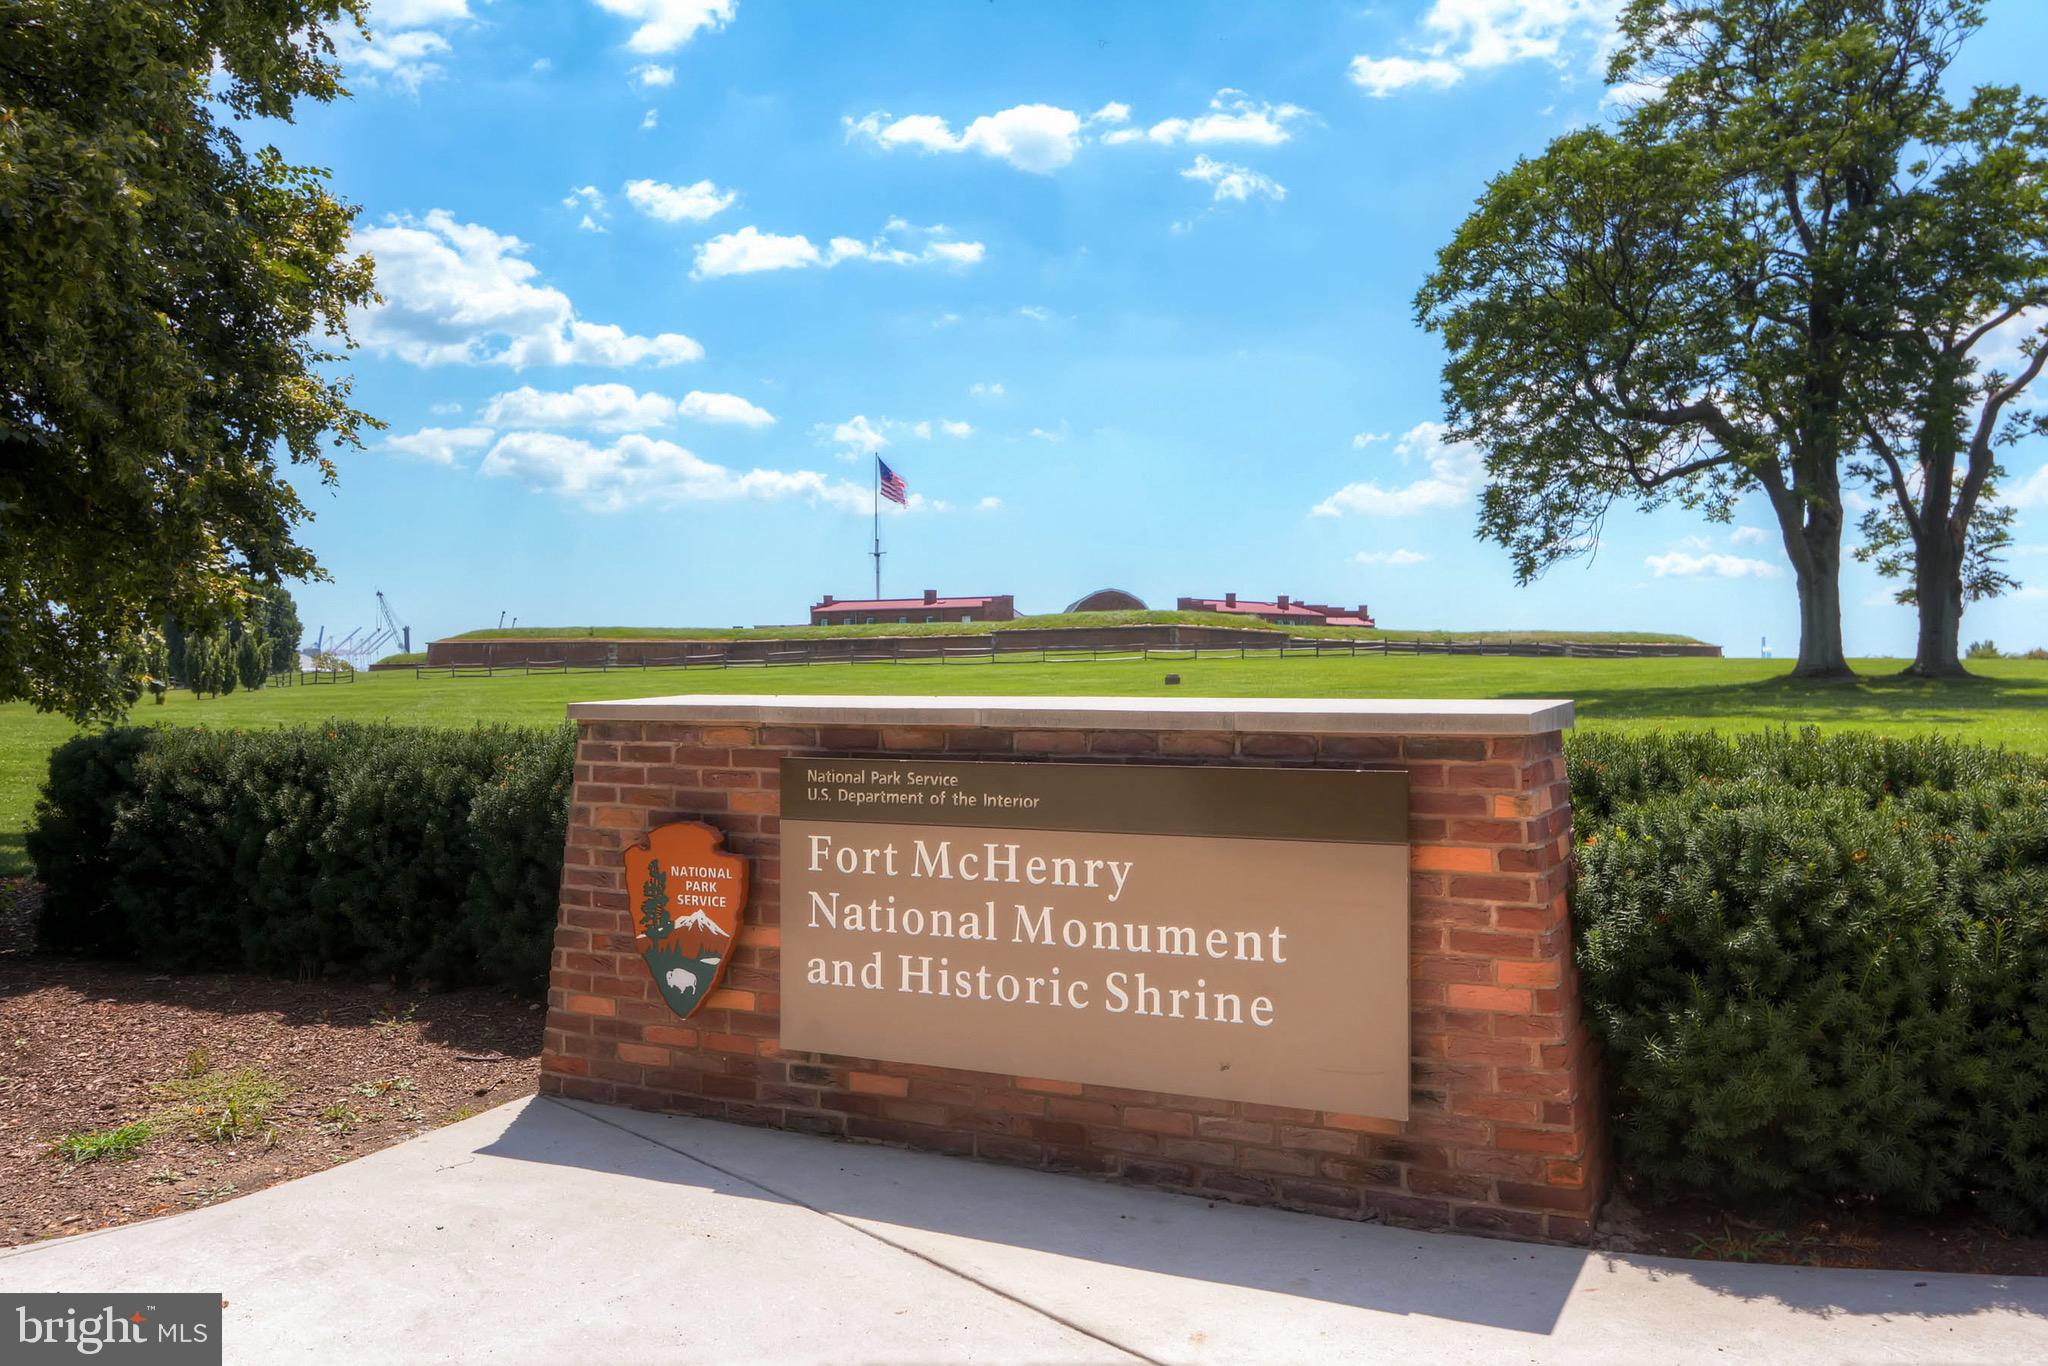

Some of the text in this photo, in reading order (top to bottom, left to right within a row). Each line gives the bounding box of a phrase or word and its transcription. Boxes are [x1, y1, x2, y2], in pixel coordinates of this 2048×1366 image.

[807, 769, 959, 787] National Park Service
[807, 787, 1040, 809] U.S. Department of the Interior
[671, 866, 732, 879] NATIONAL
[807, 835, 1134, 901] Fort McHenry
[686, 881, 717, 892] PARK
[677, 894, 727, 907] SERVICE
[807, 890, 1287, 964] National Monument
[807, 951, 1274, 1027] and Historic Shrine
